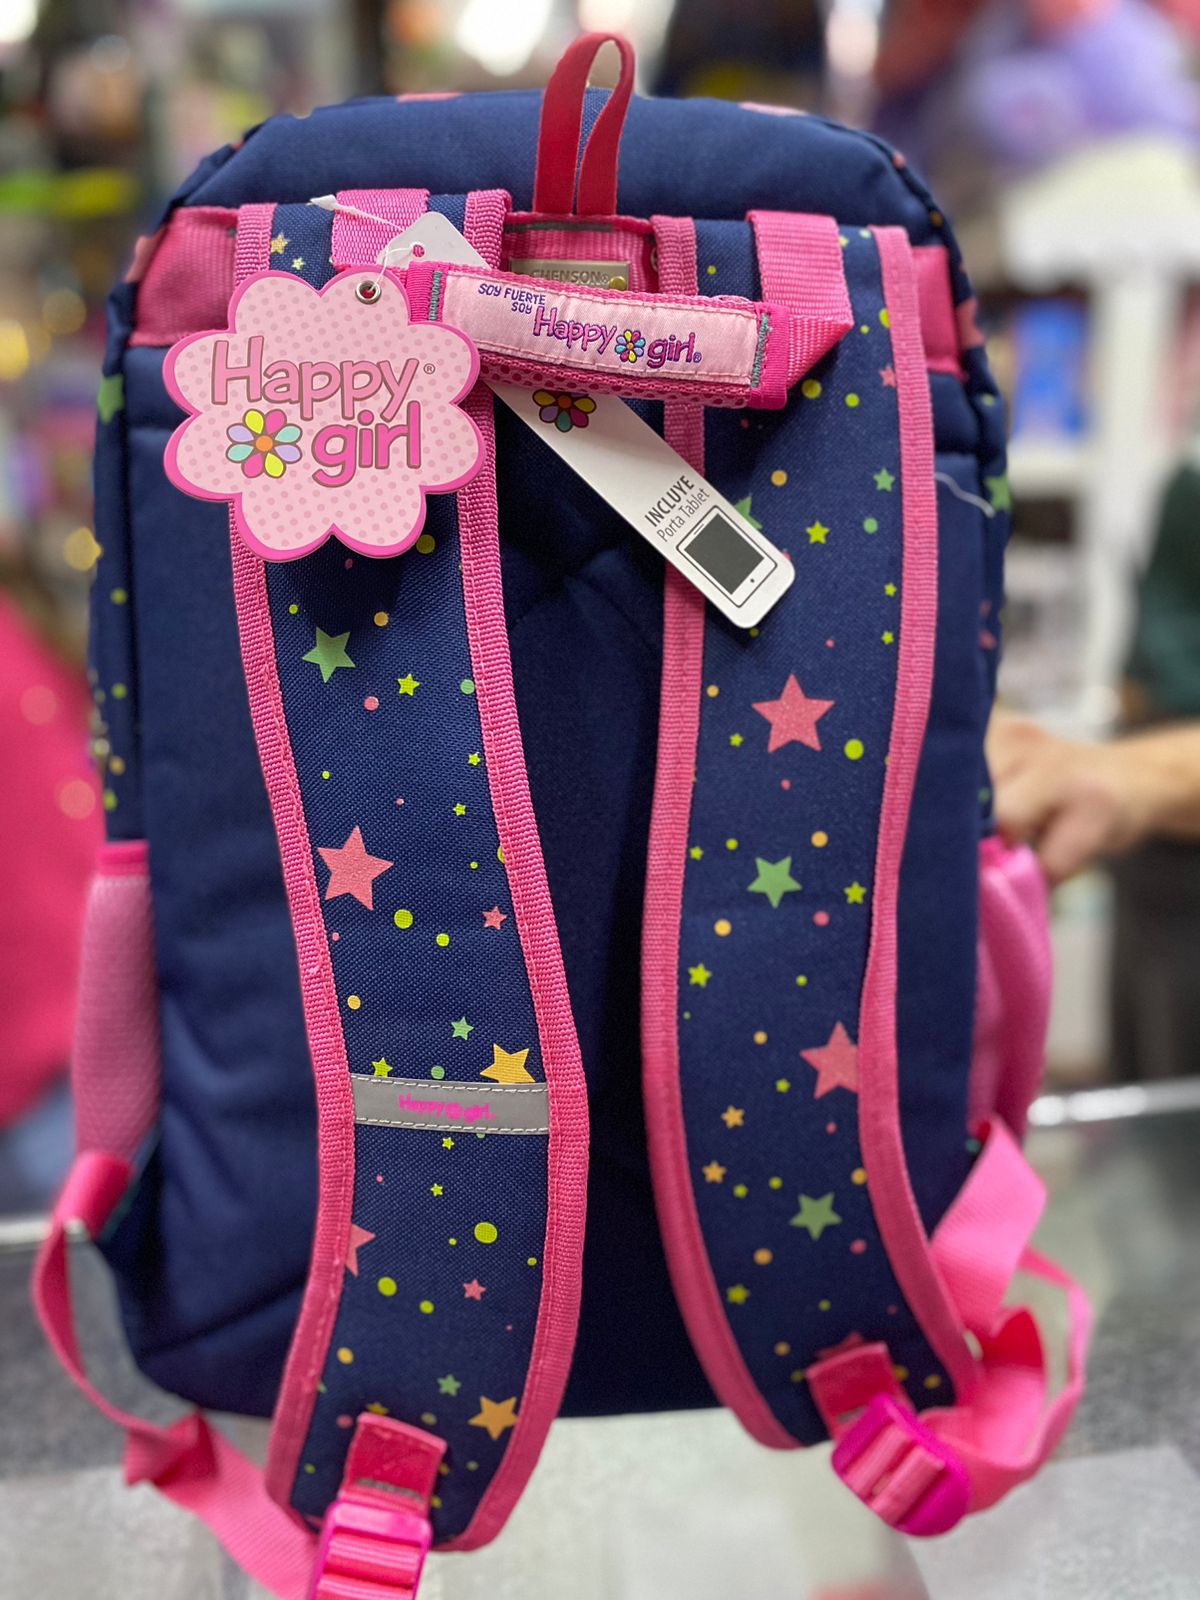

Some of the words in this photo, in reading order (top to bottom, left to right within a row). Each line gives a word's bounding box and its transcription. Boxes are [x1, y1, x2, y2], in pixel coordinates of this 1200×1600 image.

[478, 283, 502, 297] SOY
[504, 287, 546, 305] FUERTE
[511, 301, 532, 315] SOY
[533, 306, 617, 354] Happy
[647, 332, 696, 368] girl
[211, 335, 419, 422] Happy
[311, 400, 421, 487] girl
[644, 475, 694, 527] INCLUYE
[656, 518, 686, 543] Porta
[678, 488, 710, 519] Tablet
[399, 1093, 444, 1117] Happy
